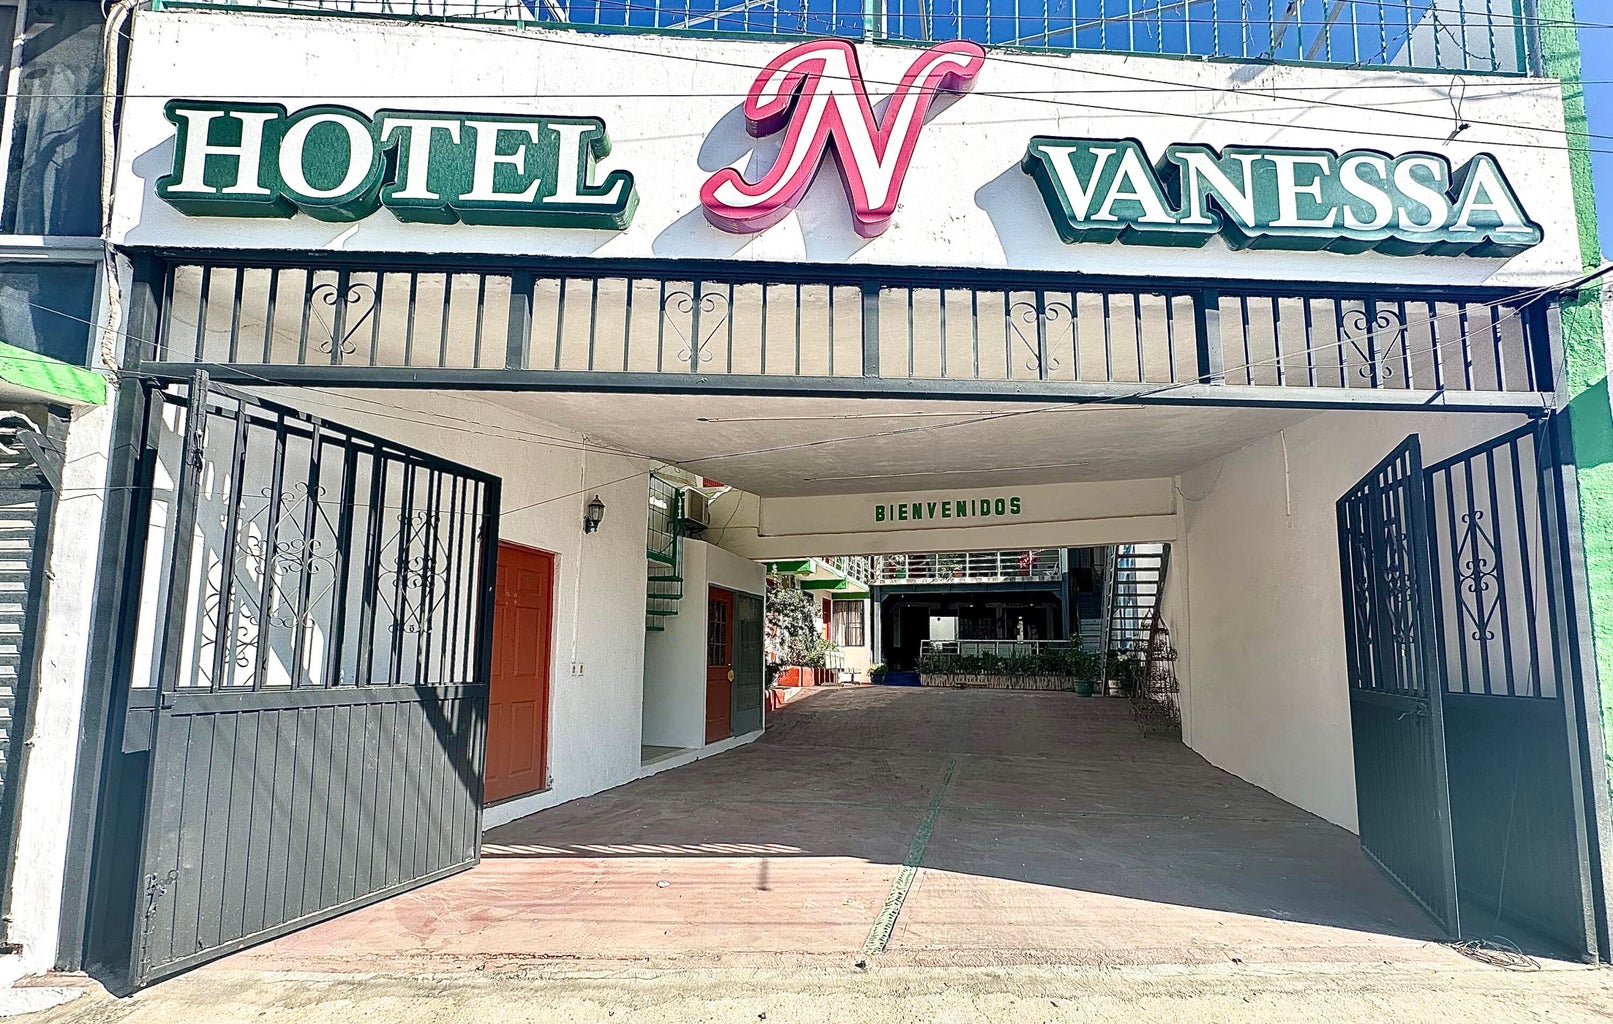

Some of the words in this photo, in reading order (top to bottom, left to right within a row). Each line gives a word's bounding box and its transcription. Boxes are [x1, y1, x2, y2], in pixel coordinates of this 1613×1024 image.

[166, 108, 628, 206] HOTEL
[1037, 144, 1534, 233] VANESSA
[874, 496, 1021, 522] BIENVENIDOS
